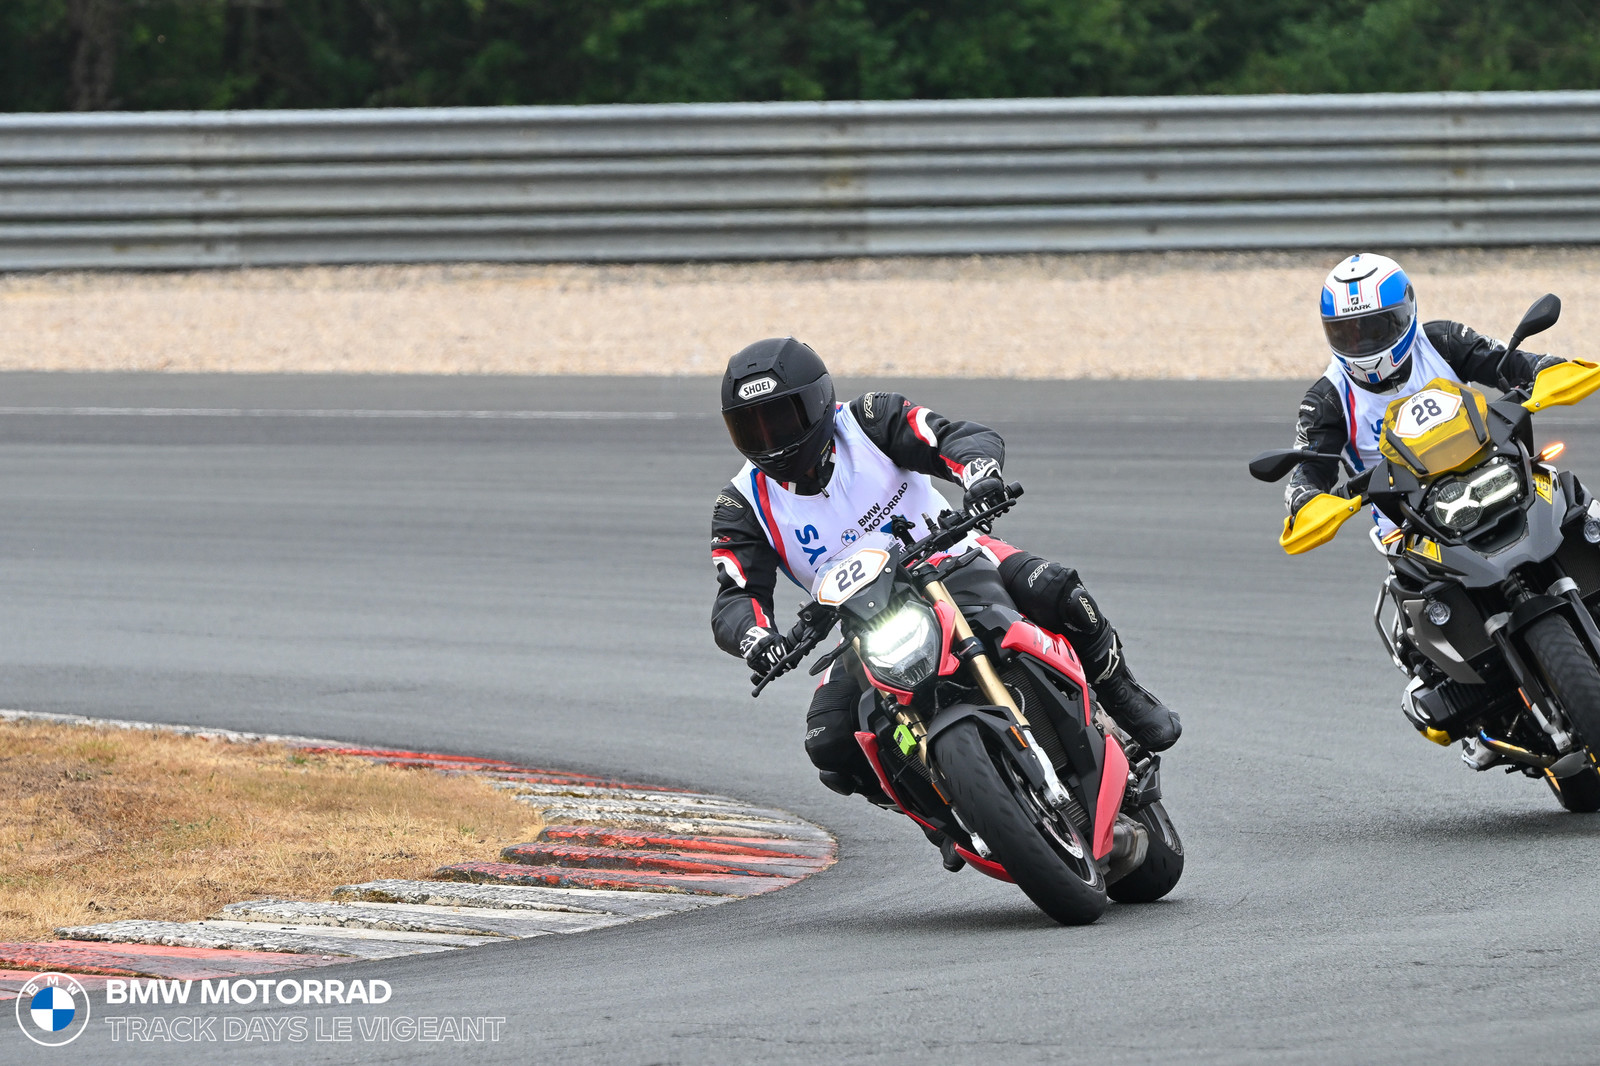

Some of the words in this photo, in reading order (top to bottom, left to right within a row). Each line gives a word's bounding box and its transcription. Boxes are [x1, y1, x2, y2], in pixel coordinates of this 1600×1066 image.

[1342, 303, 1372, 314] SHARK
[742, 379, 771, 398] SHOEI
[1411, 398, 1442, 427] 28
[857, 502, 881, 527] BMW
[864, 482, 909, 533] MOTORRAD
[835, 560, 866, 592] 22
